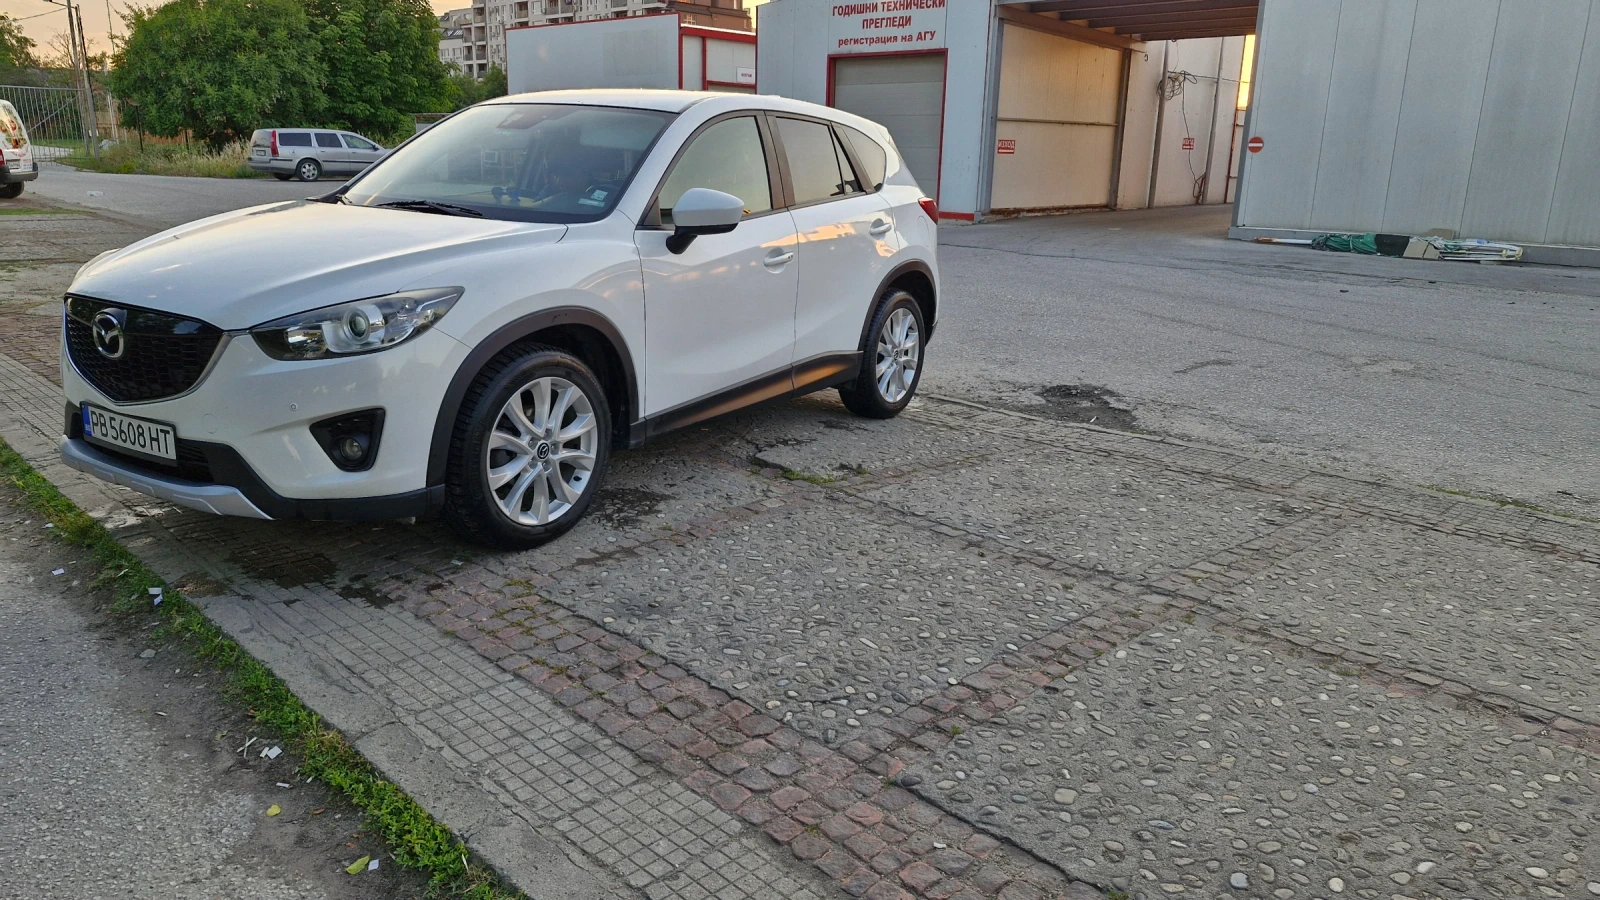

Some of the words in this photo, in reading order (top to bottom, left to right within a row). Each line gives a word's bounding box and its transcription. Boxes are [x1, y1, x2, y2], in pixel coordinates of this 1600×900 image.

[832, 2, 878, 17] ГОДИШНИ
[881, 0, 945, 12] ТЕХНИЧЕСКИ
[862, 15, 912, 29] ПРЕГЛЕДИ
[838, 35, 898, 48] регистрация
[901, 34, 913, 43] на
[916, 31, 936, 41] АГУ
